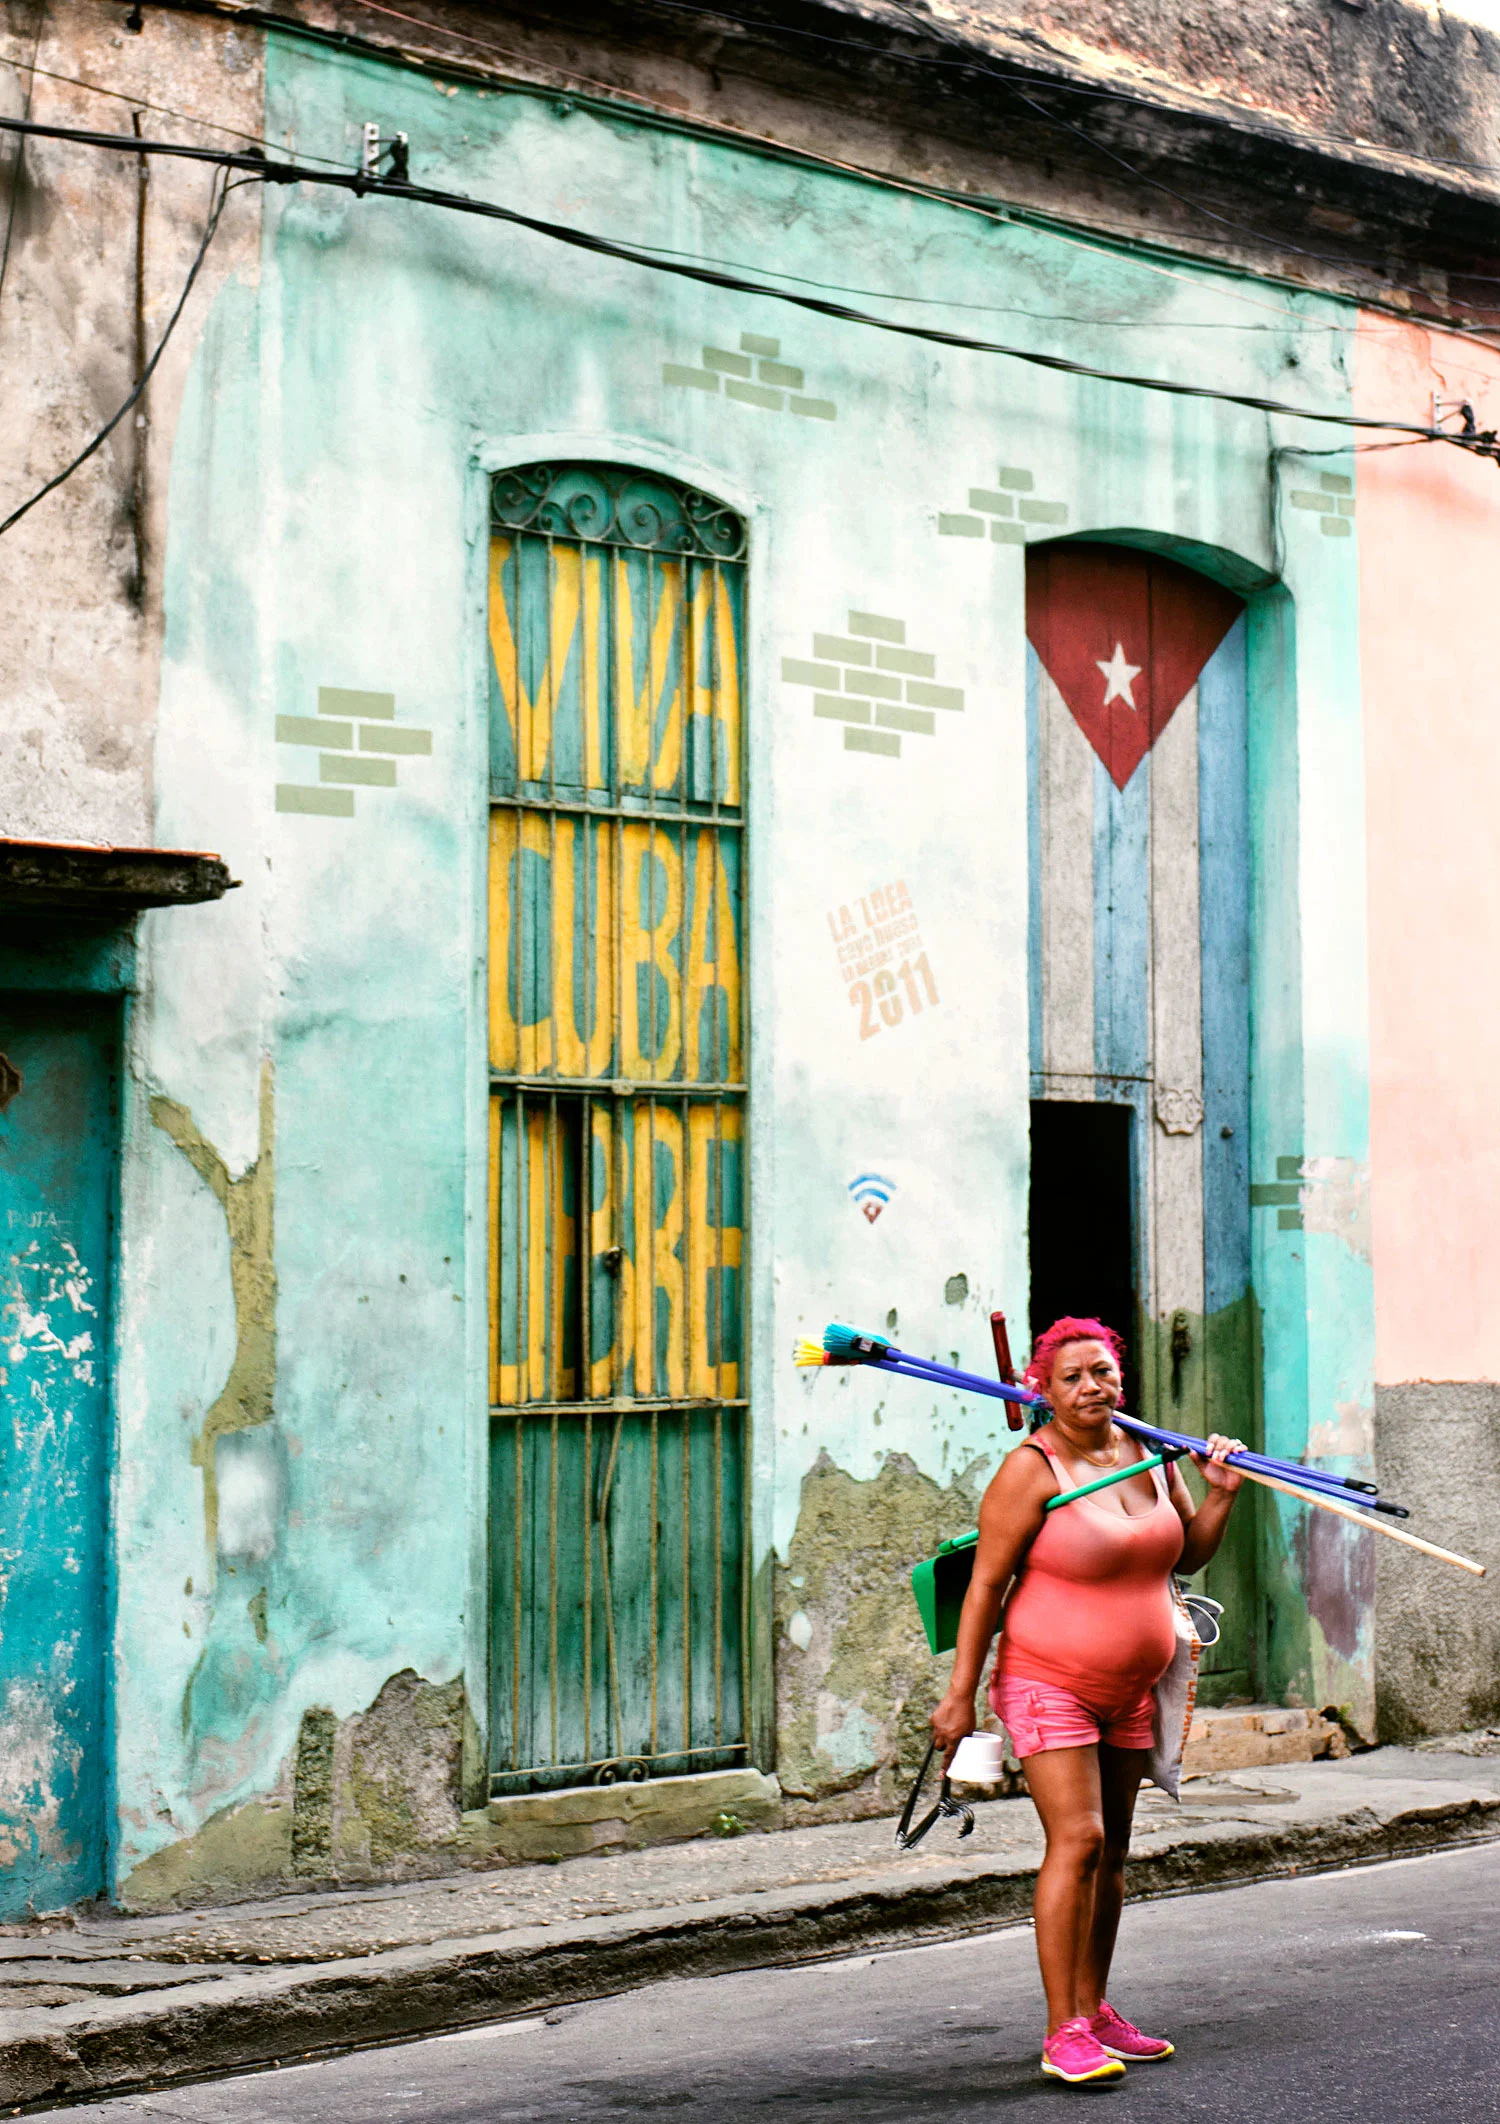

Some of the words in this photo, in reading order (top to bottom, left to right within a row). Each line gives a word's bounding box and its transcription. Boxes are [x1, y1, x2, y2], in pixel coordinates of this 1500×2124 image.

[488, 535, 741, 807] VIVA
[488, 808, 744, 1084] CUBA
[848, 950, 940, 1042] 2011
[488, 1094, 743, 1406] LIBRE
